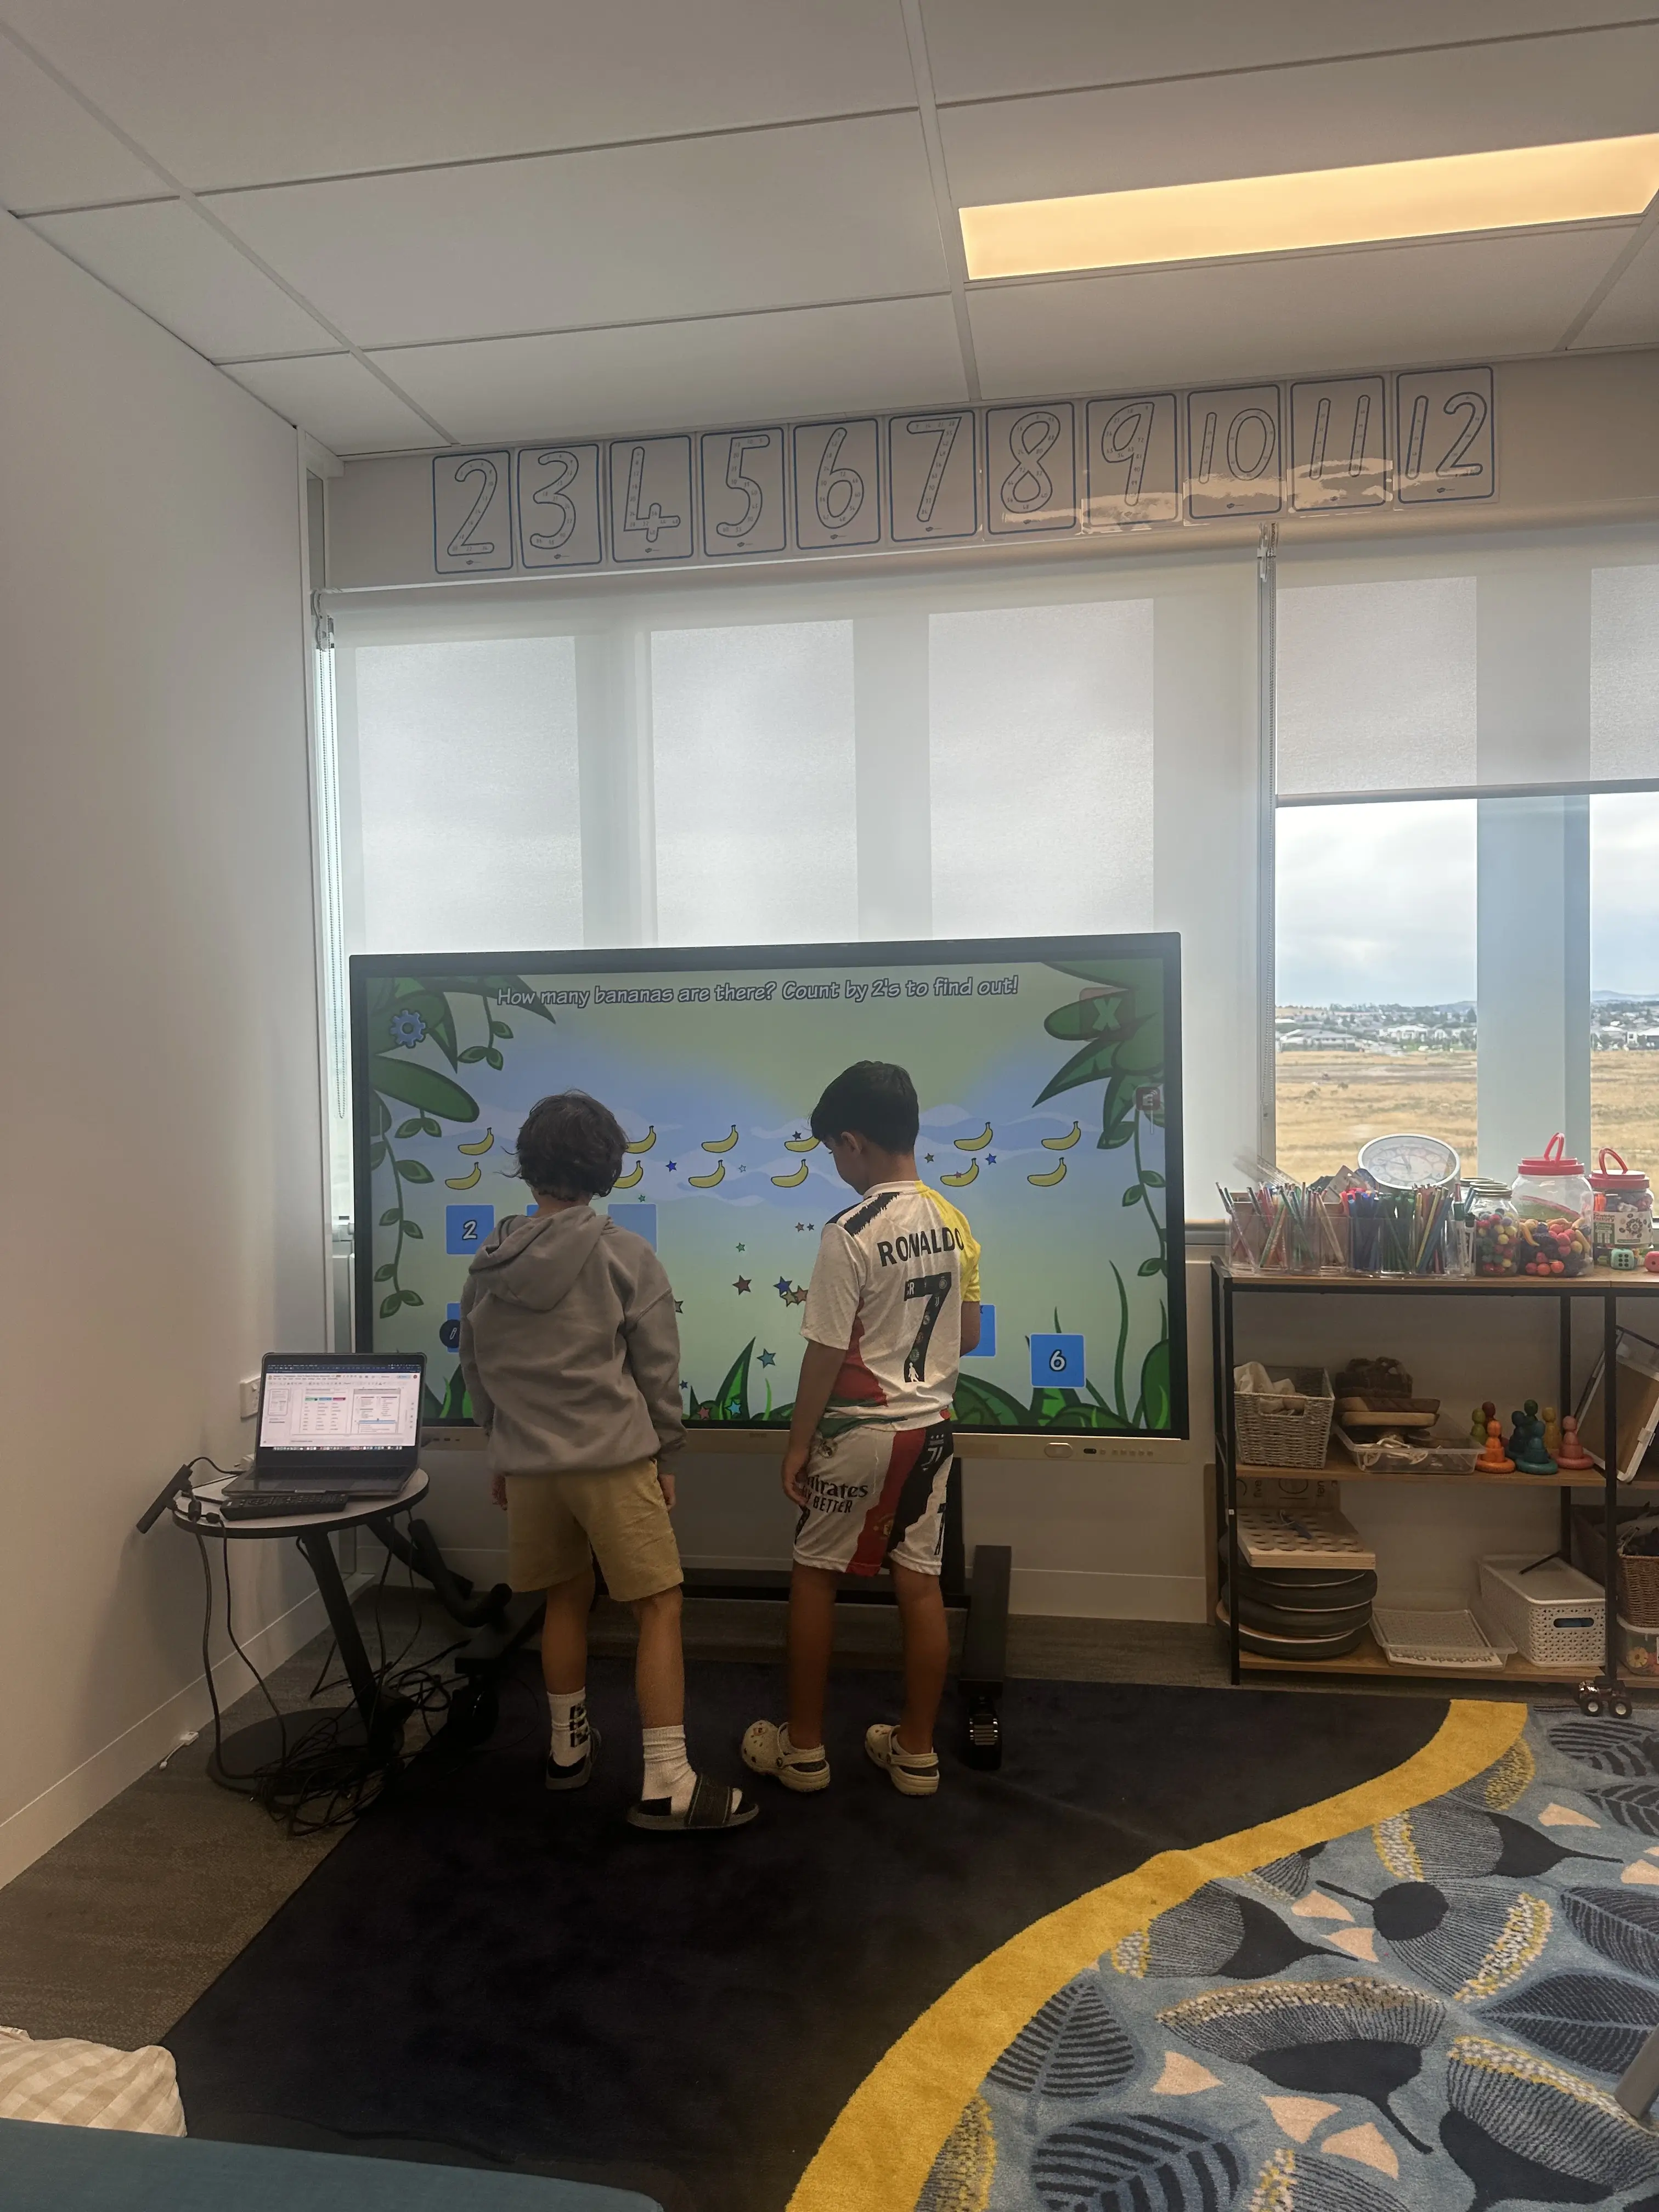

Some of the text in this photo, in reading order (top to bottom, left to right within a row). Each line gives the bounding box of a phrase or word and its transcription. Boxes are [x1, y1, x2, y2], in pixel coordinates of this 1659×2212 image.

[816, 427, 864, 529] 6
[907, 416, 962, 522] 7
[1001, 411, 1060, 514] 8
[1102, 402, 1155, 507] 9
[1199, 408, 1276, 484] 10
[1308, 394, 1370, 480] 11
[1405, 391, 1488, 481] 12
[447, 459, 498, 556] 2
[530, 451, 579, 550] 3
[624, 446, 680, 543] 4
[716, 435, 770, 538] 5
[496, 974, 1019, 1008] How many bananas are there? Count by 2's to find out!
[462, 1219, 478, 1240] 2
[876, 1227, 964, 1267] RONALDO
[904, 1272, 952, 1383] 7
[1048, 1349, 1067, 1373] 6
[812, 1496, 853, 1513] BETTER
